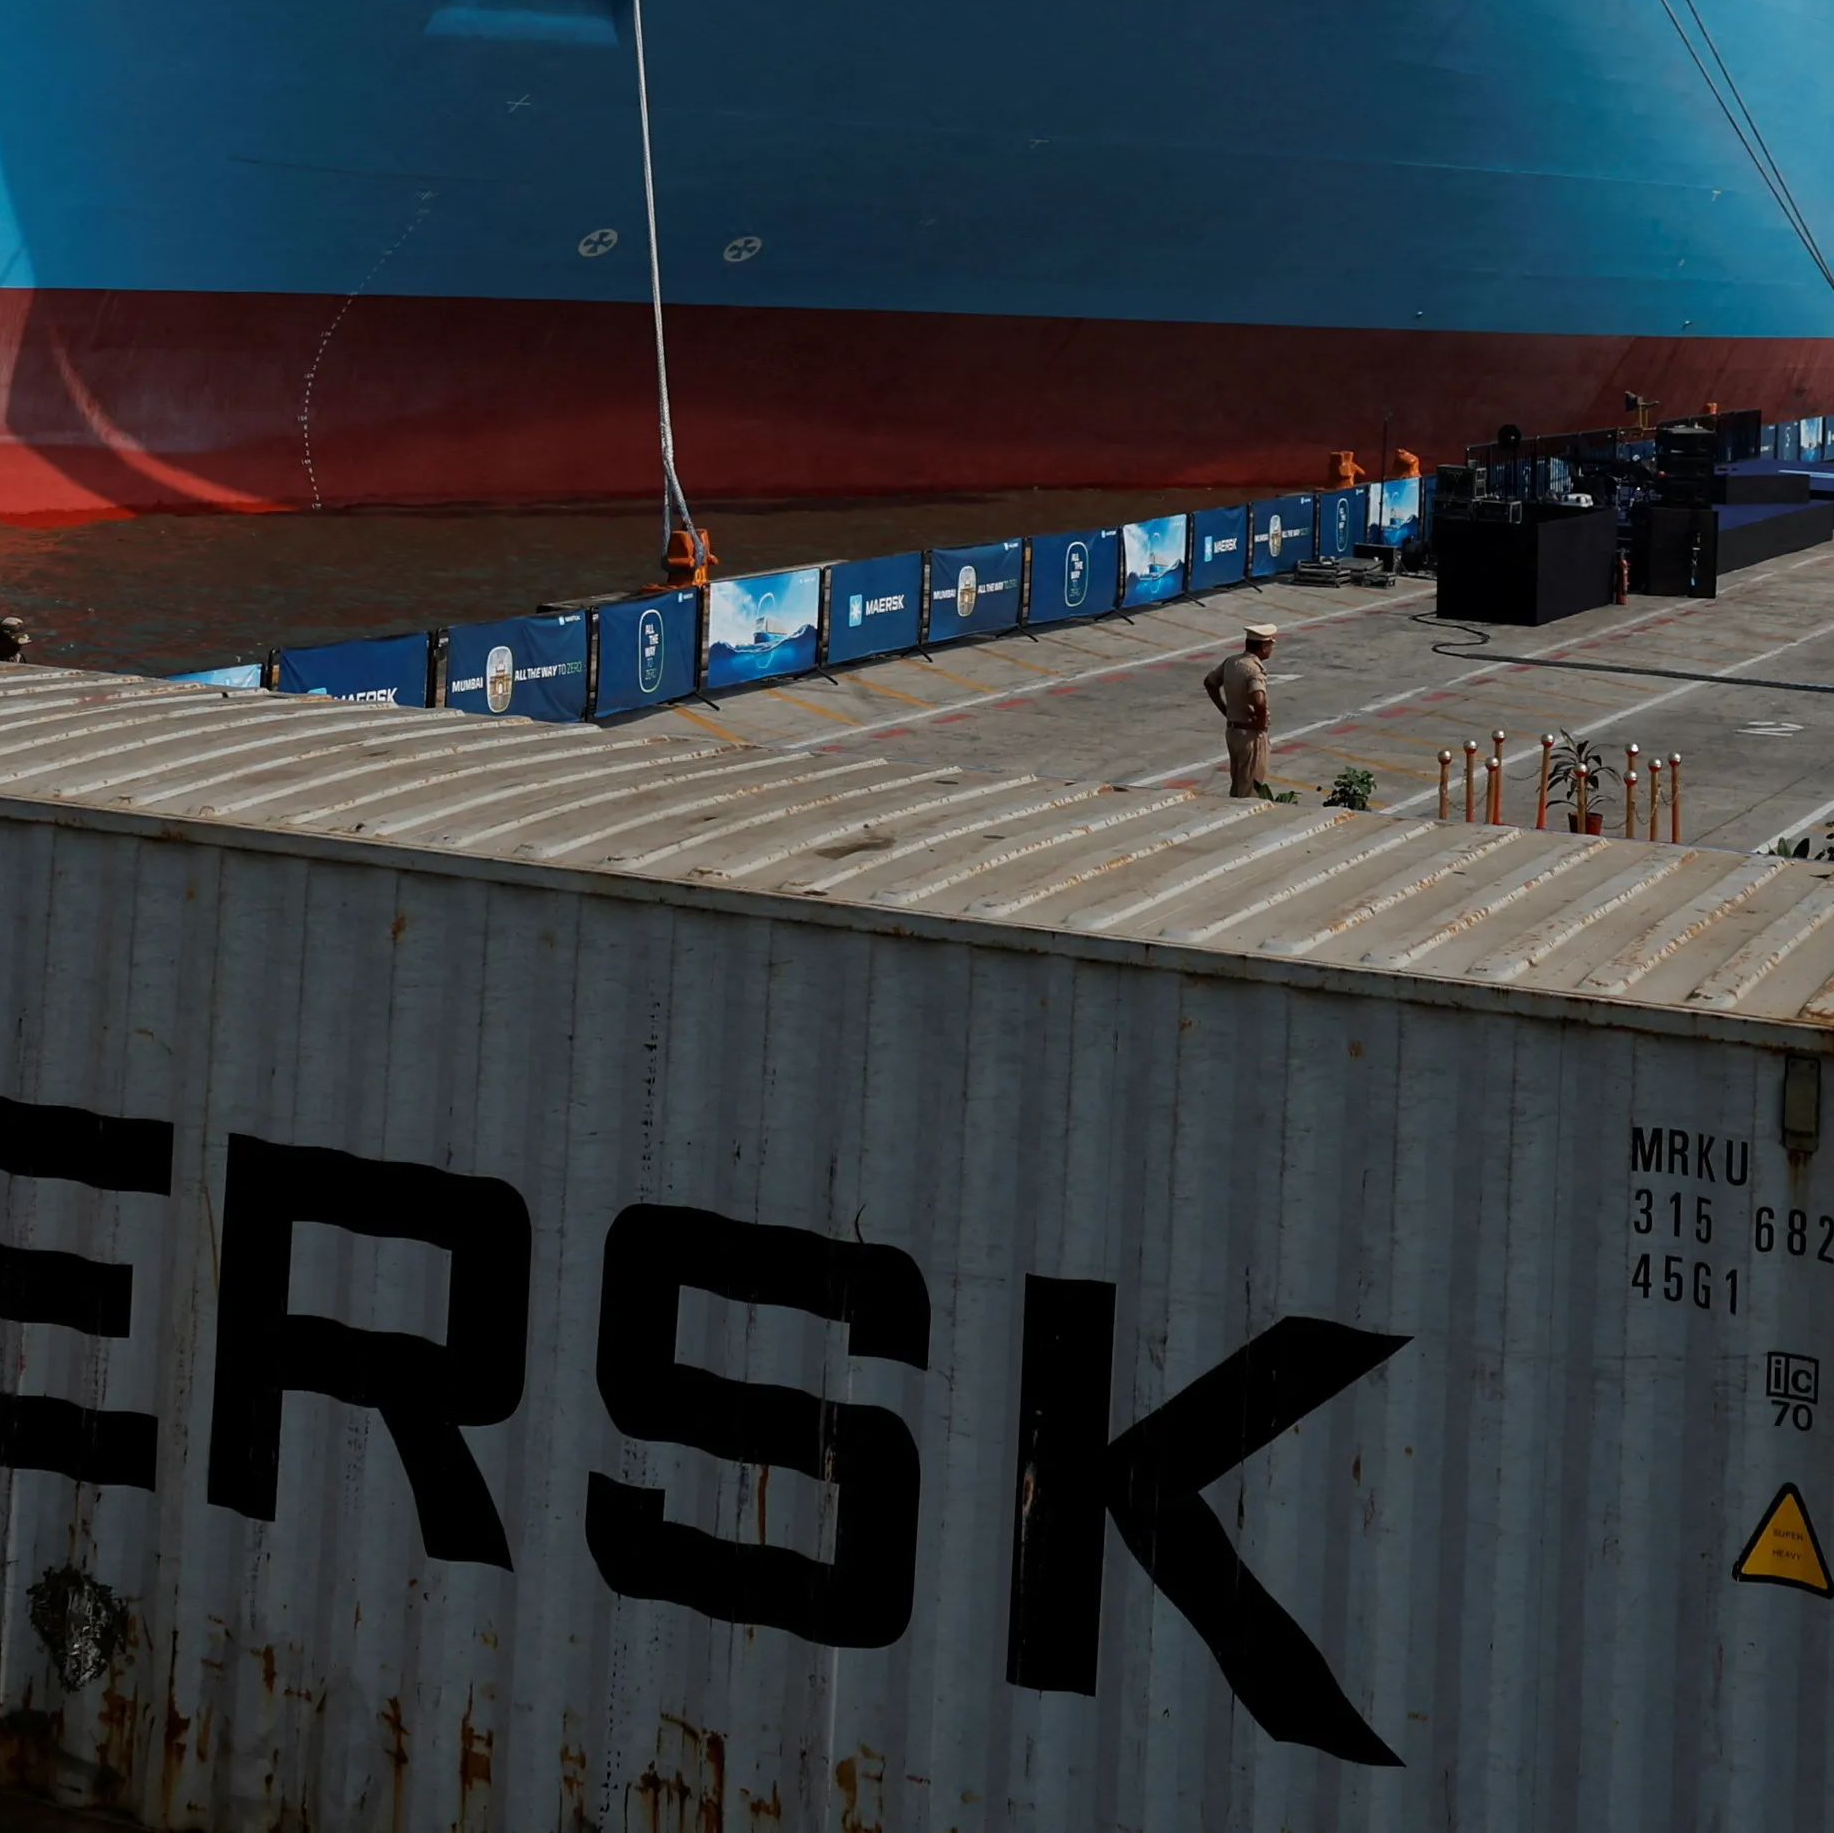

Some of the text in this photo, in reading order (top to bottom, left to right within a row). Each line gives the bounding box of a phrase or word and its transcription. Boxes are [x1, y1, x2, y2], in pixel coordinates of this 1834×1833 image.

[1213, 537, 1238, 554] MAERSK
[865, 594, 905, 616] MAERSK
[514, 661, 582, 682] ALL THE WAY TO ZERO
[333, 687, 398, 703] RSK
[451, 677, 484, 694] MUMBAI
[1631, 1127, 1749, 1187] MRKU
[1633, 1188, 1712, 1245] 315
[1631, 1253, 1739, 1316] 45G1
[1771, 1400, 1814, 1431] 70
[1773, 1529, 1804, 1541] SUPER
[1773, 1549, 1802, 1560] HEAVY
